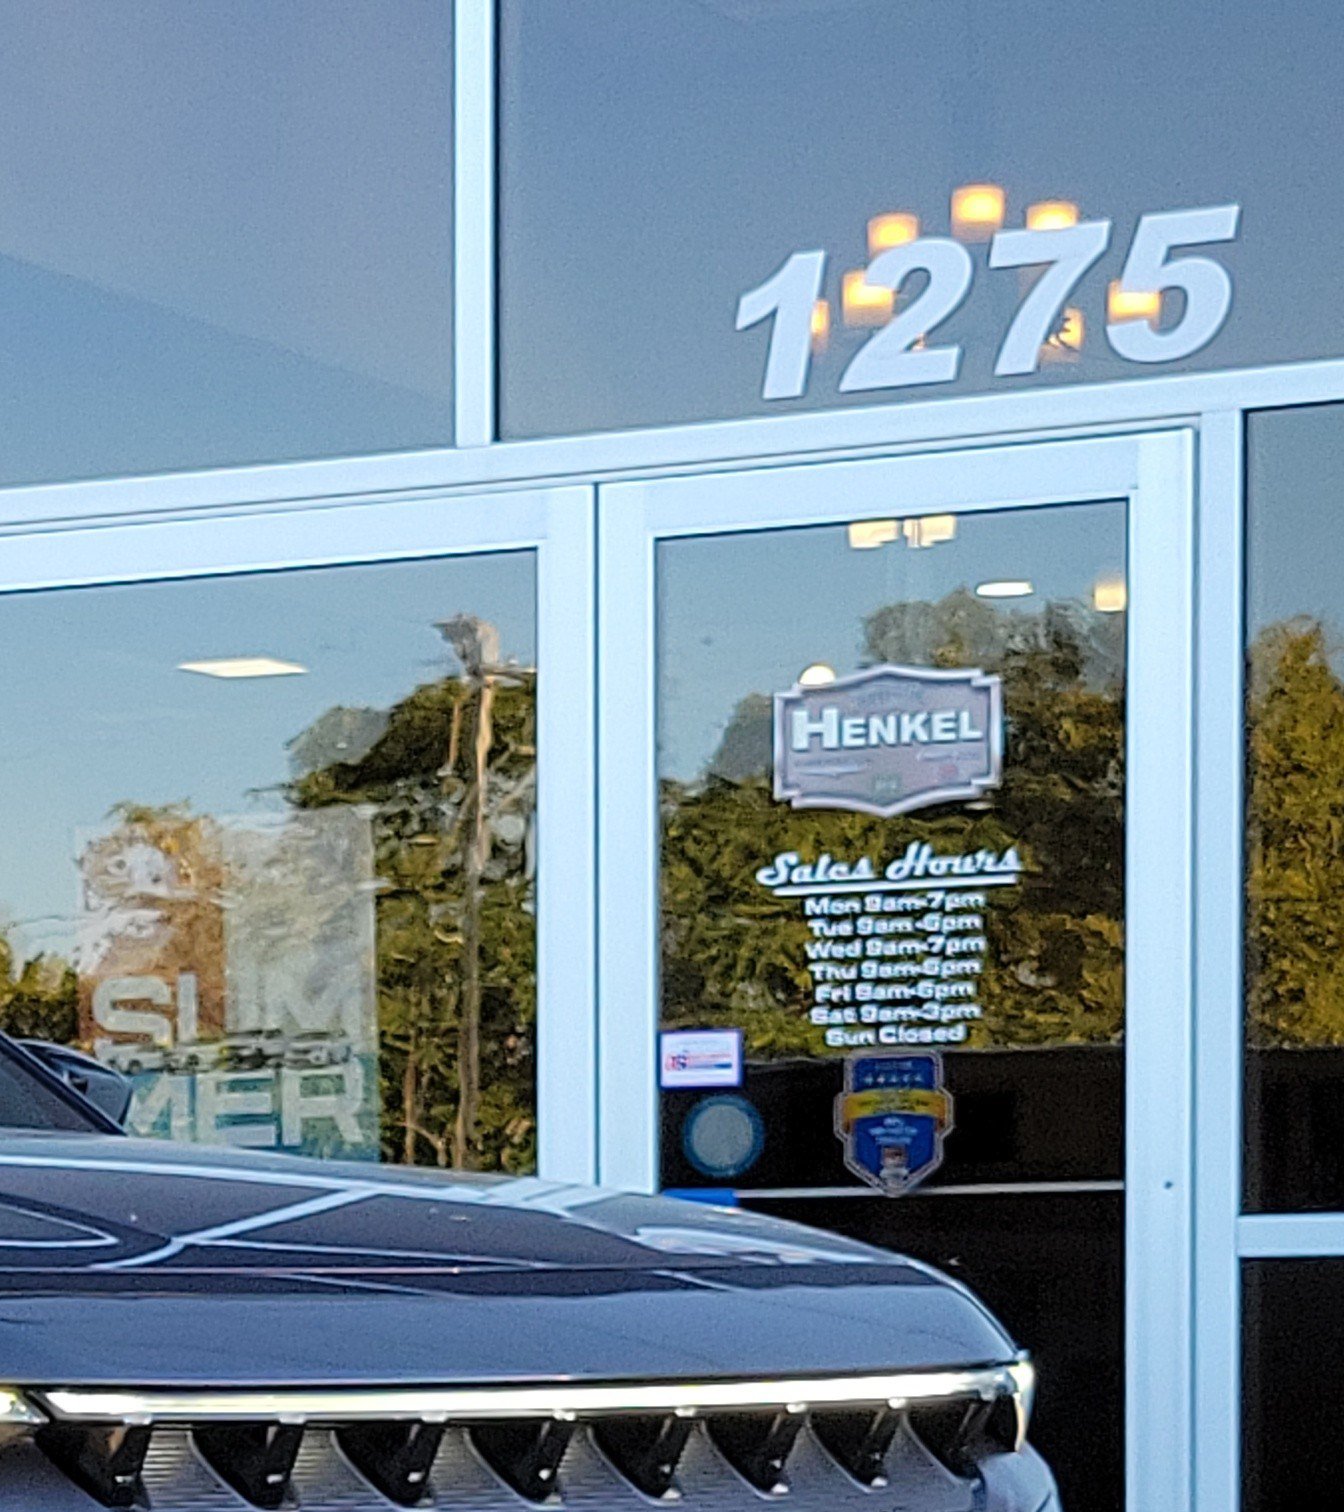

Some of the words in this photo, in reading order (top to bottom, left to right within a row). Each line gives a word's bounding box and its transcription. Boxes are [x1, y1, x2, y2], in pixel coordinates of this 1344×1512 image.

[735, 204, 1239, 399] 1275
[790, 707, 984, 751] HENKEL
[755, 851, 877, 886] Sales
[885, 840, 1023, 881] Hours
[805, 896, 861, 916] Mon
[807, 917, 853, 937] Tue
[805, 939, 861, 960] Wed
[807, 961, 858, 980] Thu
[814, 982, 852, 1002] Fri
[810, 1005, 858, 1025] Sat
[825, 1026, 876, 1046] Sun
[878, 1023, 967, 1044] Closed
